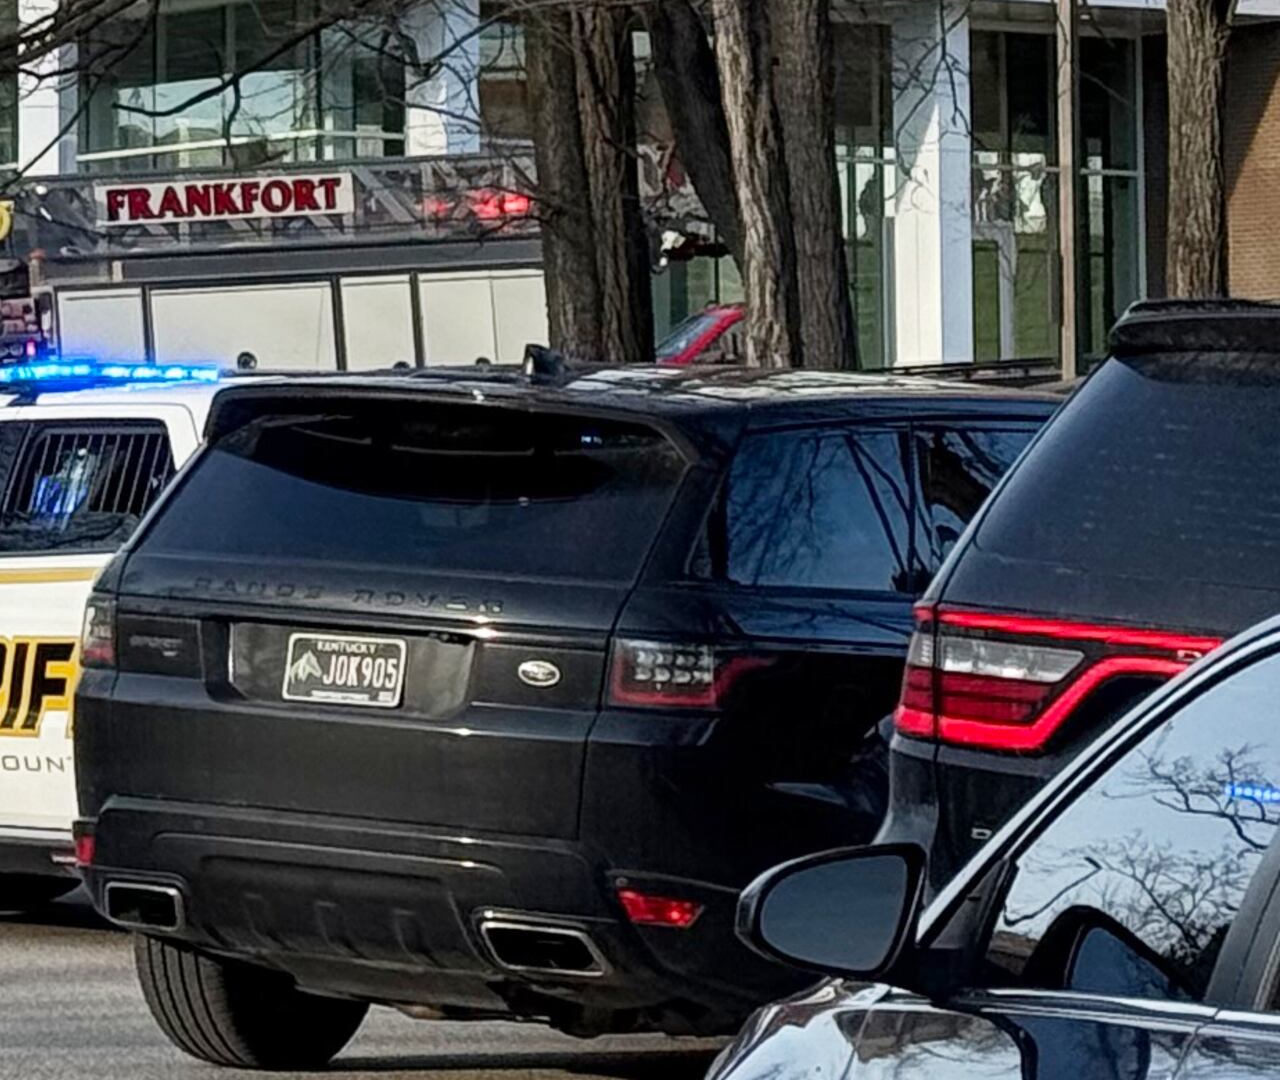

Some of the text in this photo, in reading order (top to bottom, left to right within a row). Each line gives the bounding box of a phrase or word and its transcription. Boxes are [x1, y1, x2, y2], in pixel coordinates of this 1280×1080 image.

[106, 178, 342, 221] FRANKFORT
[195, 576, 504, 614] RANGE ROVER
[317, 641, 377, 655] KENTUCKY
[322, 654, 398, 689] JOK905
